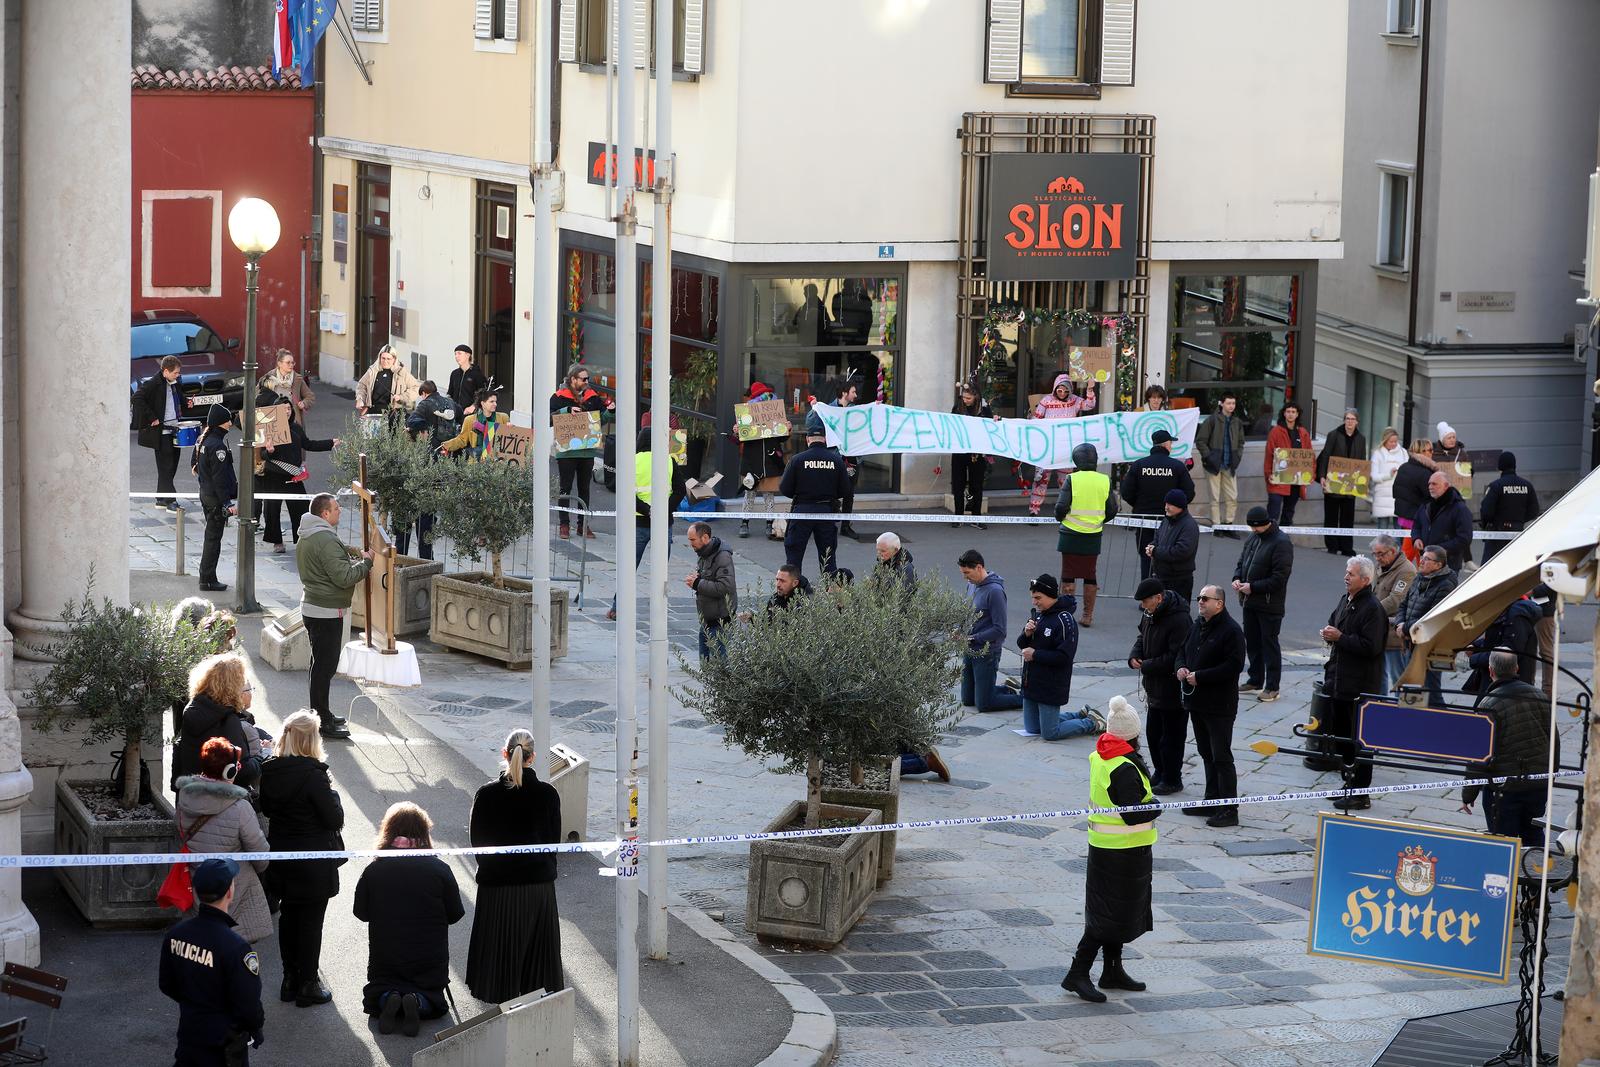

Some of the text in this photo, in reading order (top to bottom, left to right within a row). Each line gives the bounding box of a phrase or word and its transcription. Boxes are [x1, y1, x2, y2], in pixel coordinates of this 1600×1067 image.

[1004, 203, 1124, 250] SLON
[883, 246, 889, 254] 4
[804, 460, 835, 470] POLICIJA
[1142, 467, 1173, 477] POLICIJA
[1503, 485, 1528, 495] POLICIJA
[1341, 885, 1481, 946] Hirter
[170, 938, 214, 968] POLICIJA
